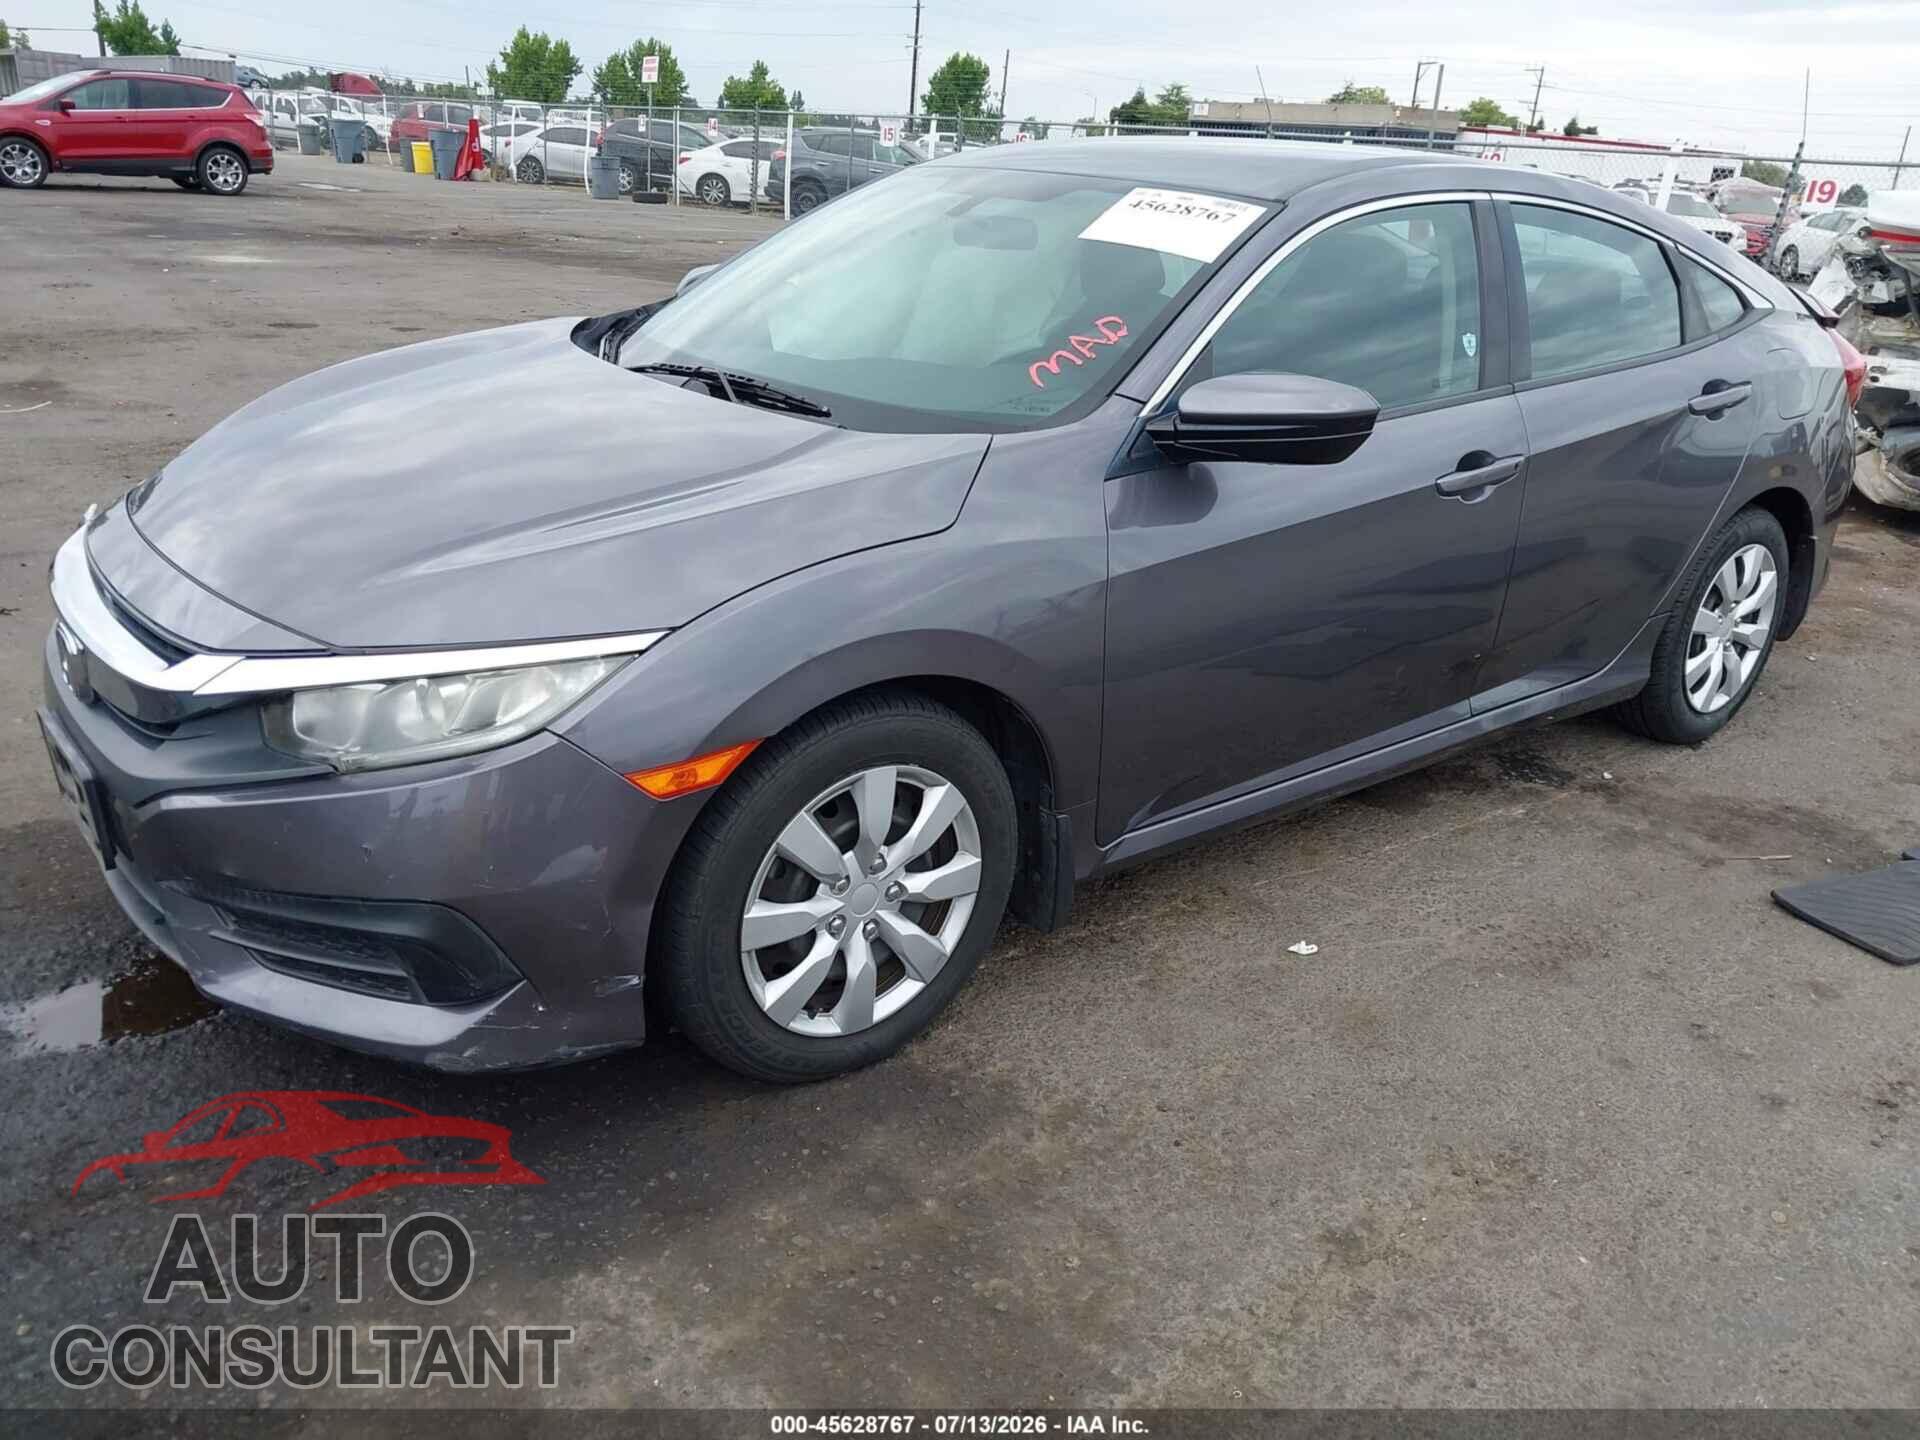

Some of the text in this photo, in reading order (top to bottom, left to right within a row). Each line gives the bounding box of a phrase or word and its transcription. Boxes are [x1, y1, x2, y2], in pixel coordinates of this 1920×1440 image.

[883, 127, 894, 142] 15
[1806, 180, 1837, 204] 19
[1128, 200, 1237, 223] 45628767
